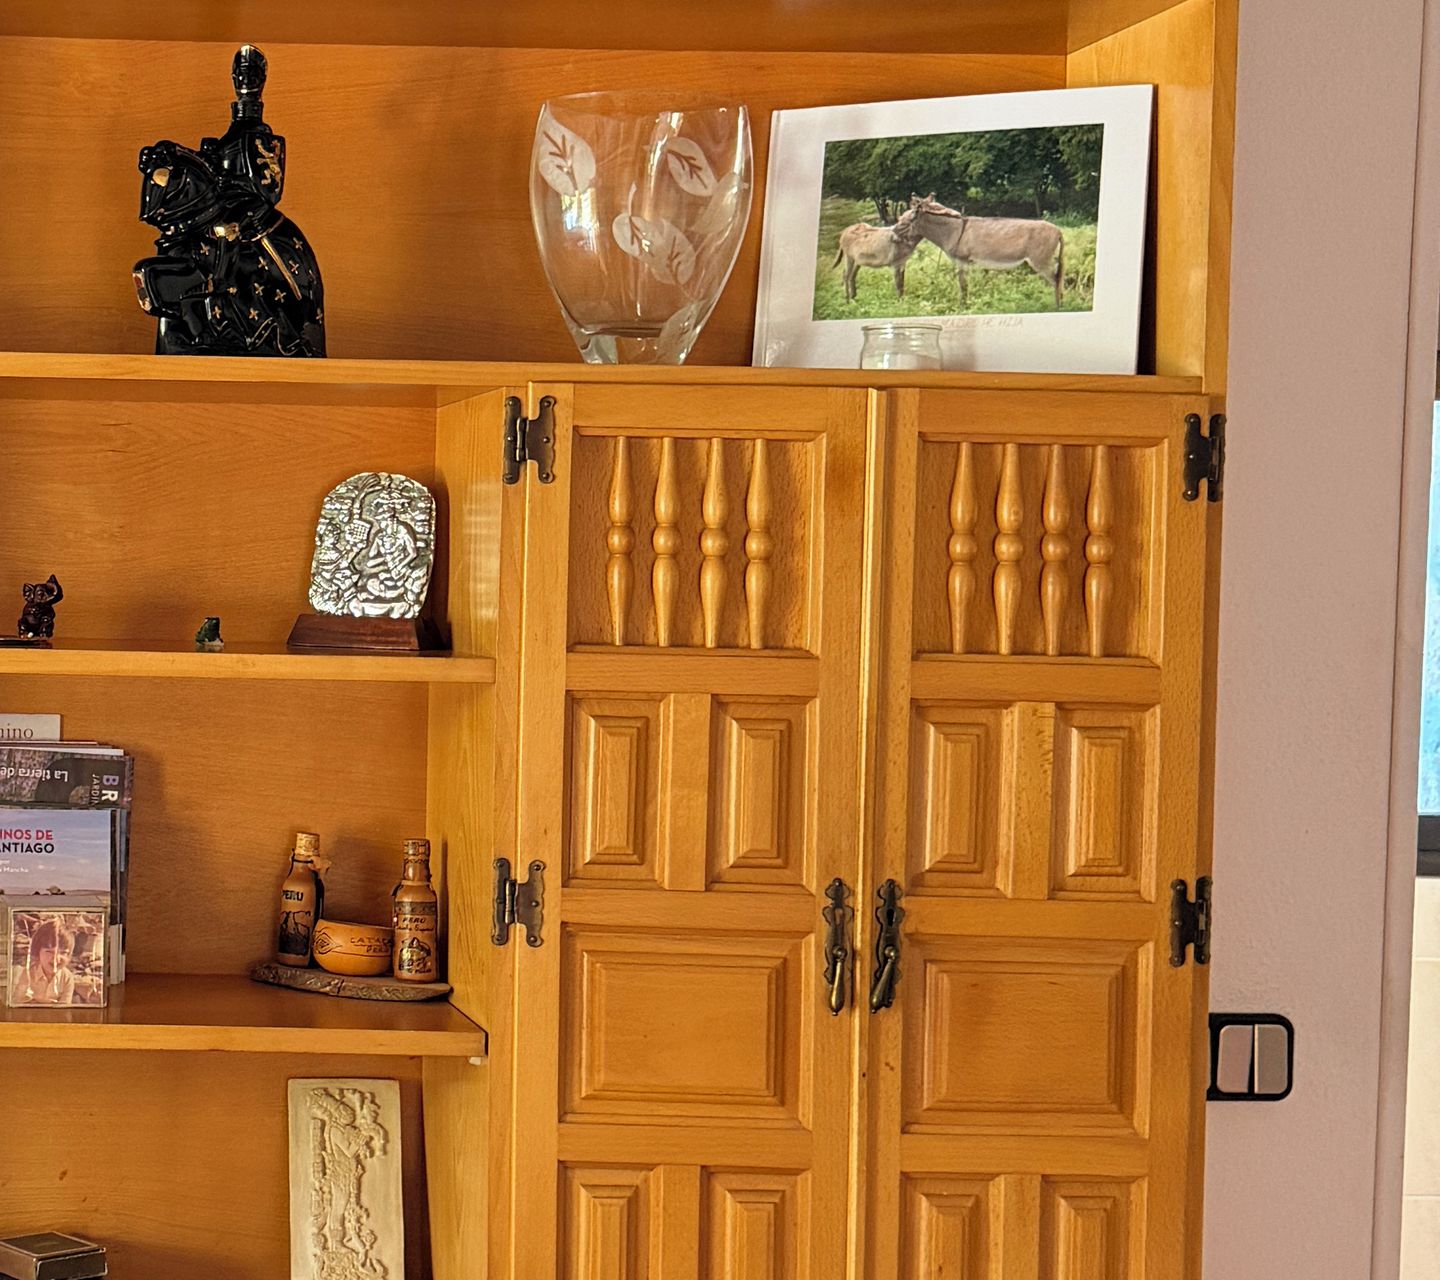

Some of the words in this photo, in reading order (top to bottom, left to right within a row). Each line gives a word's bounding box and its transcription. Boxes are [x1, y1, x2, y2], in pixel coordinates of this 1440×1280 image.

[0, 766, 15, 779] de
[17, 767, 52, 781] tierra
[54, 769, 69, 782] La
[34, 829, 54, 841] DE
